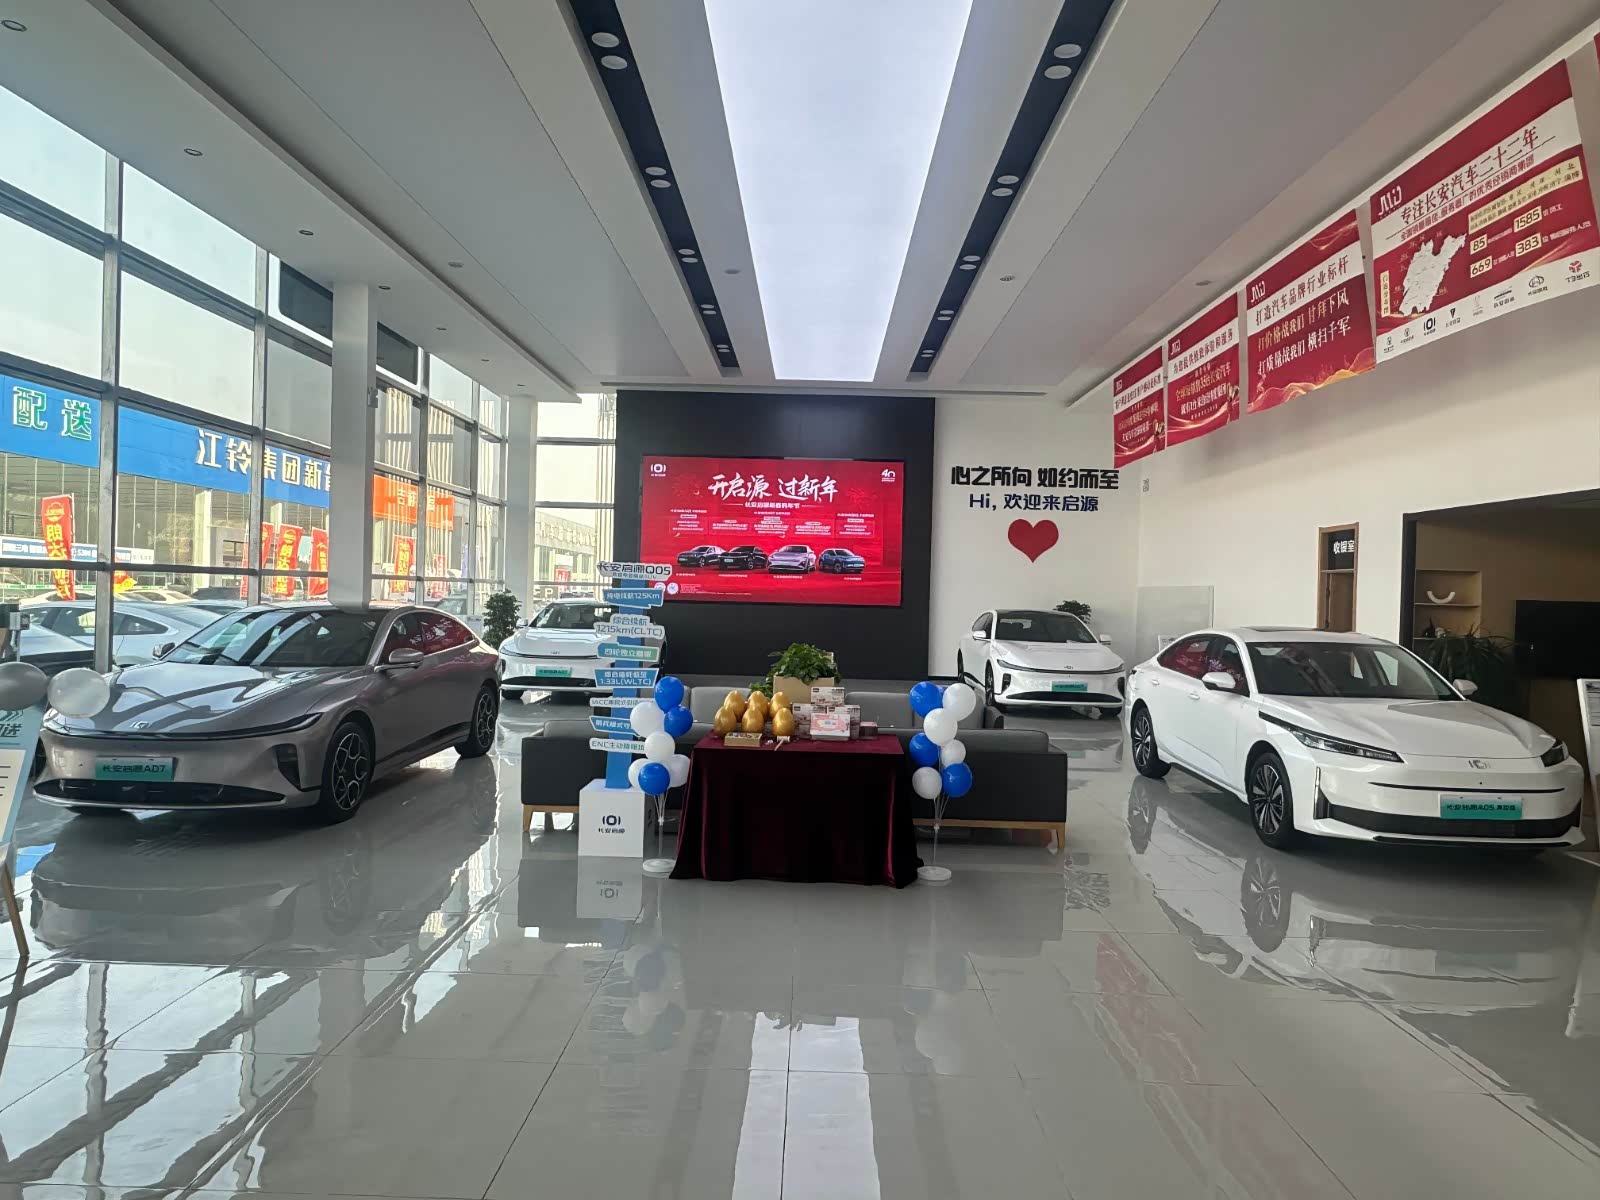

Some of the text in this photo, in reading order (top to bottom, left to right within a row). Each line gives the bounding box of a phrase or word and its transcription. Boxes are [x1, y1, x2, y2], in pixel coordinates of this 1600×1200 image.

[1400, 126, 1539, 225] 专注长安汽车二十二年
[1515, 208, 1541, 229] 1585
[1472, 235, 1486, 251] 85
[1517, 235, 1540, 255] 383
[1471, 258, 1491, 275] 669
[1255, 254, 1350, 326] 打造汽车品牌行业标杆
[1308, 287, 1350, 325] 甘拜下风
[1257, 315, 1352, 376] 打质量战我们 横扫千军
[12, 385, 92, 441] 配送
[707, 472, 838, 503] 开启源 过新年
[951, 465, 1119, 490] 心之所向 如约而至
[1003, 493, 1099, 512] 欢迎来启源
[1333, 540, 1355, 555] 收银室
[597, 562, 671, 576] 长安启源Q05
[596, 624, 663, 638] 1215km(CLTC)
[613, 616, 648, 626] 综合续航
[595, 719, 632, 729] 哨兵模式守
